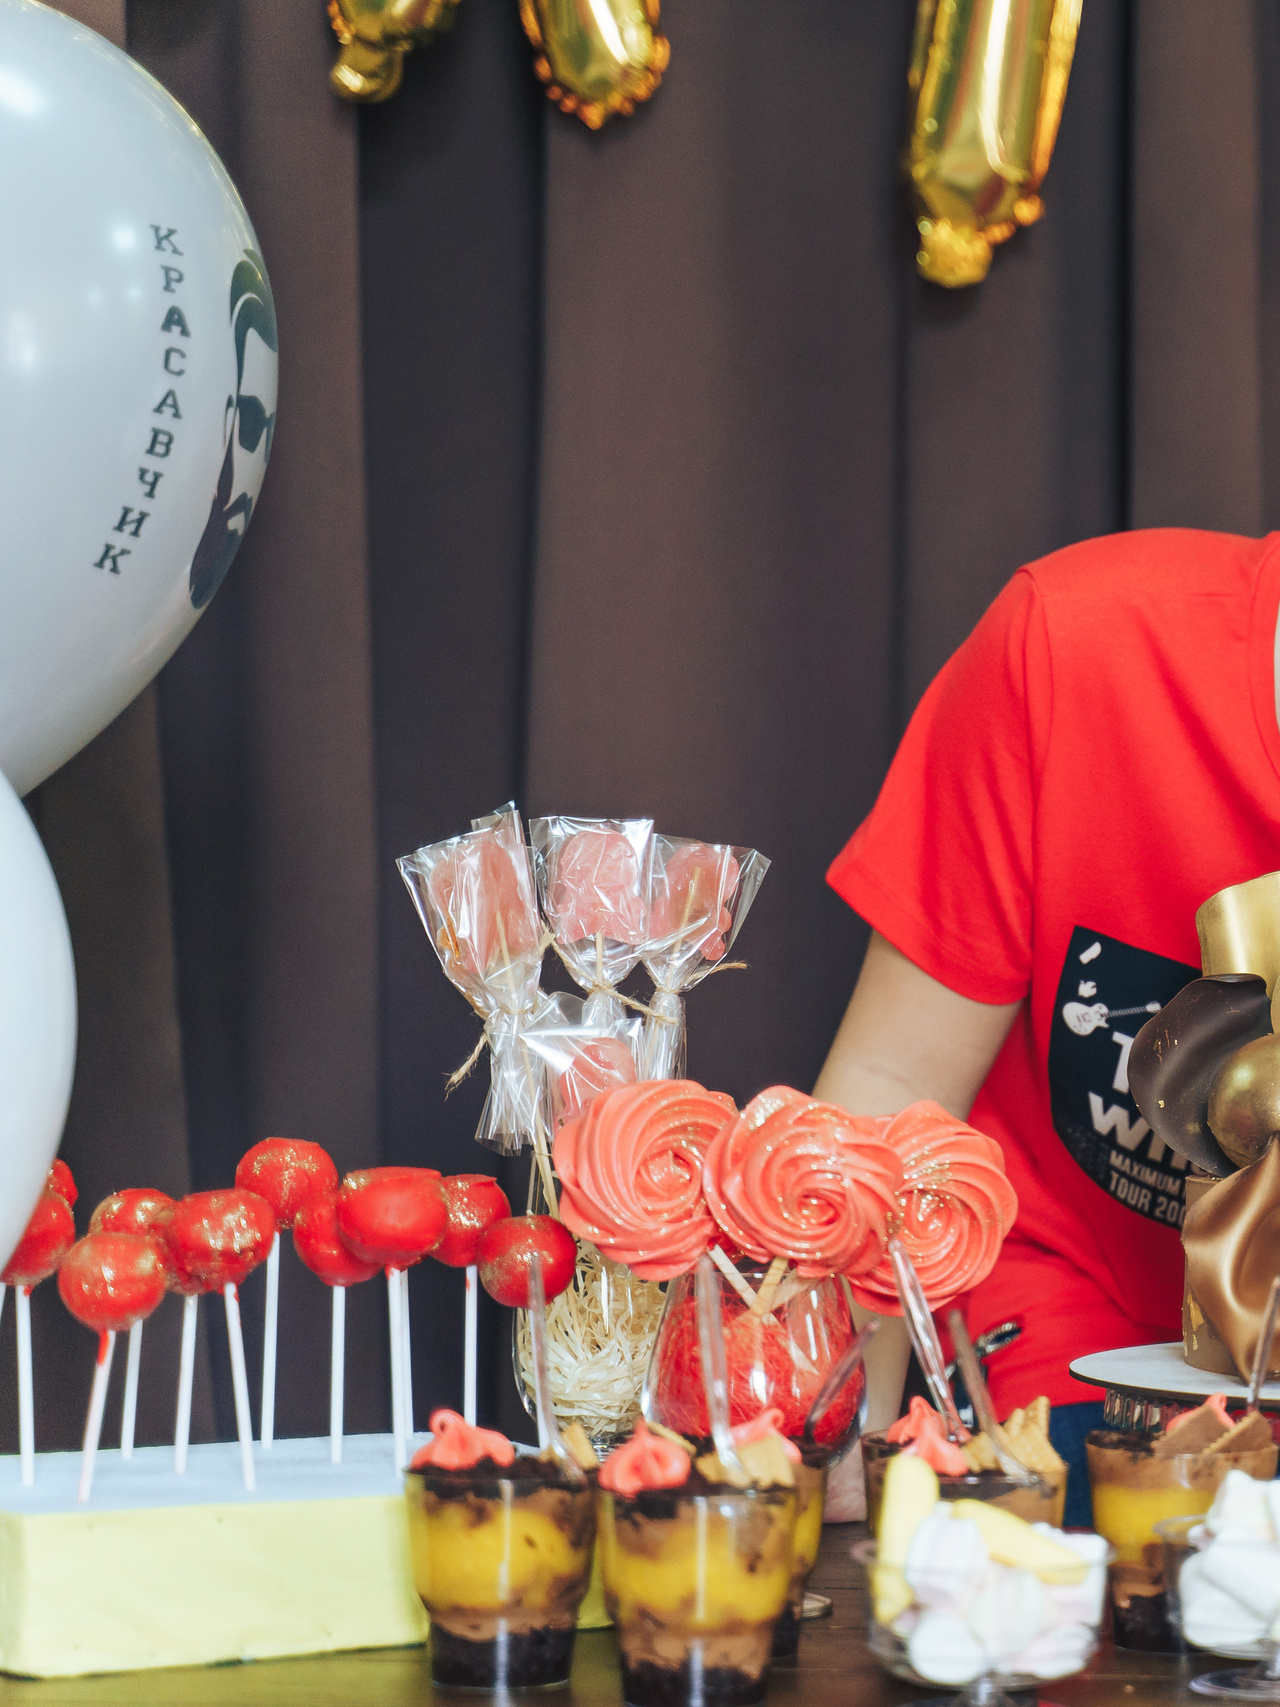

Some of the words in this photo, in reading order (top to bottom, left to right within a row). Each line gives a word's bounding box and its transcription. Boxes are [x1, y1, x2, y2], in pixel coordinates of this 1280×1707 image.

[94, 224, 191, 575] КРАСАВЧИК
[1109, 1150, 1181, 1196] MAXIMUM
[1109, 1170, 1152, 1212] TOUR
